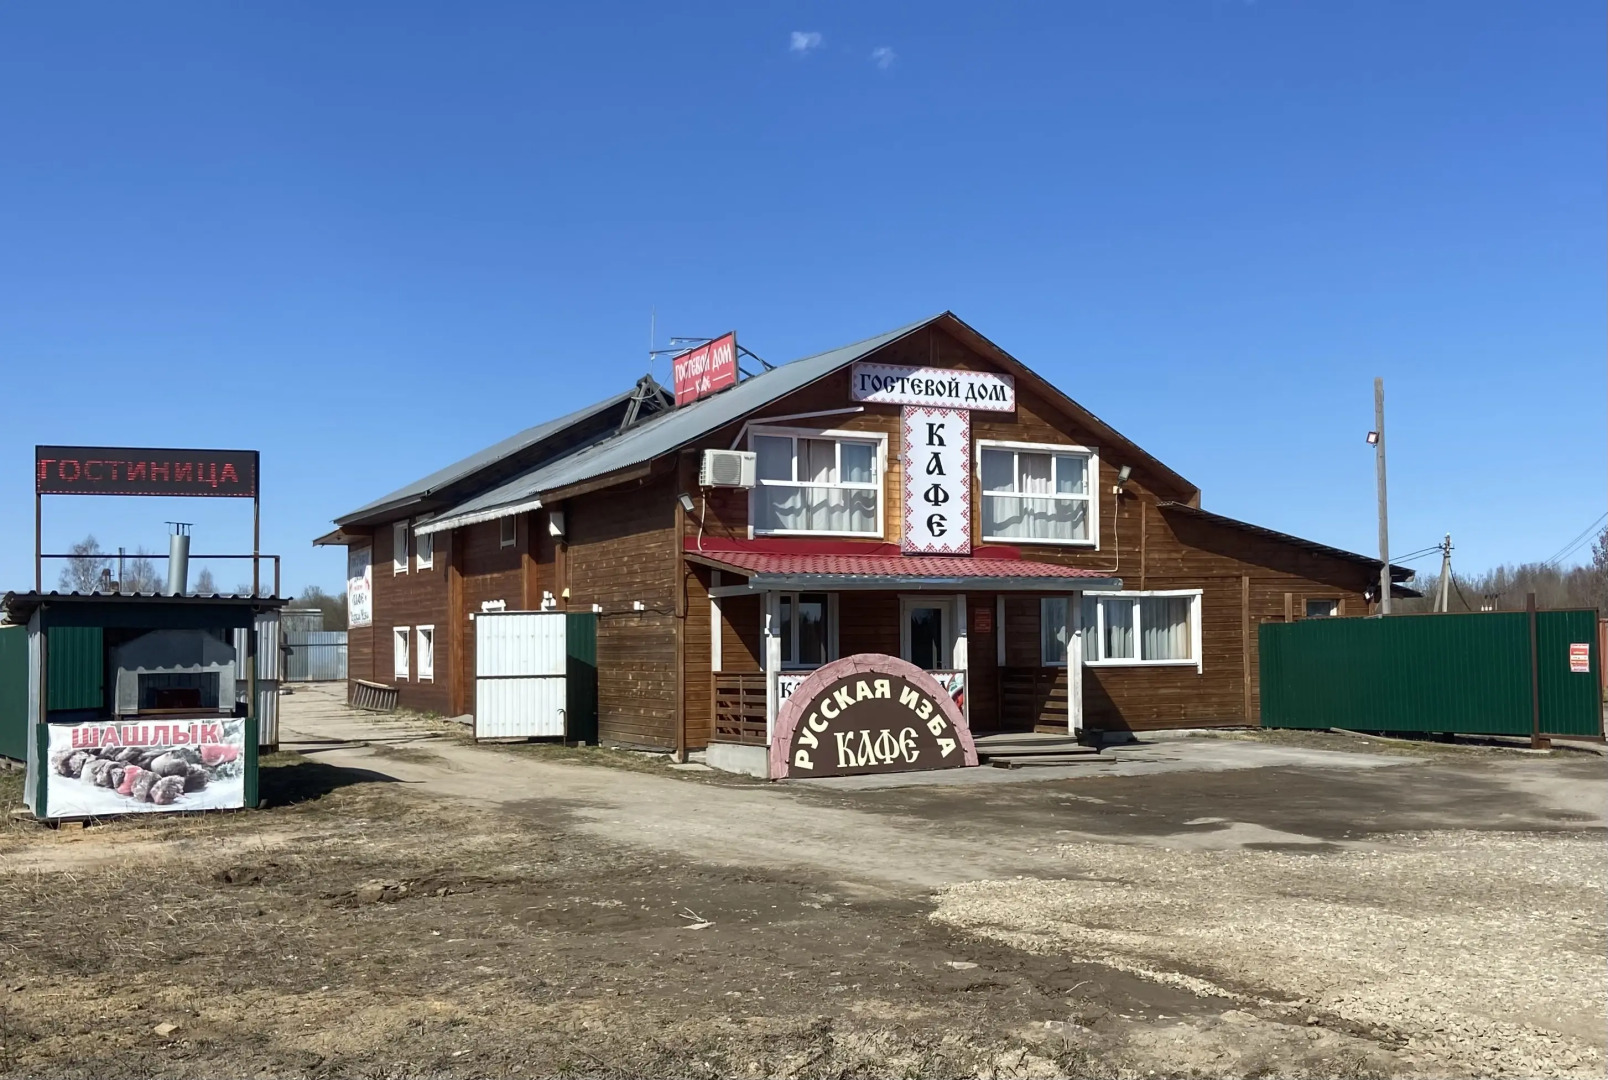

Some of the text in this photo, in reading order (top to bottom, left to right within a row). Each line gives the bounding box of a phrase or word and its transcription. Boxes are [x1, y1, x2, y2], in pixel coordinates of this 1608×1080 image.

[675, 342, 732, 384] ГОСТЕВОЙ ДОМ
[859, 373, 1008, 403] ГОСТЕВОЙ ДОМ
[40, 459, 239, 488] ГОСТИНИЦА
[923, 422, 950, 538] КАФЕ
[71, 723, 220, 750] ШАШЛЫК
[794, 678, 958, 770] РУССКАЯ ИЗБА
[833, 727, 921, 769] КАФЕ
